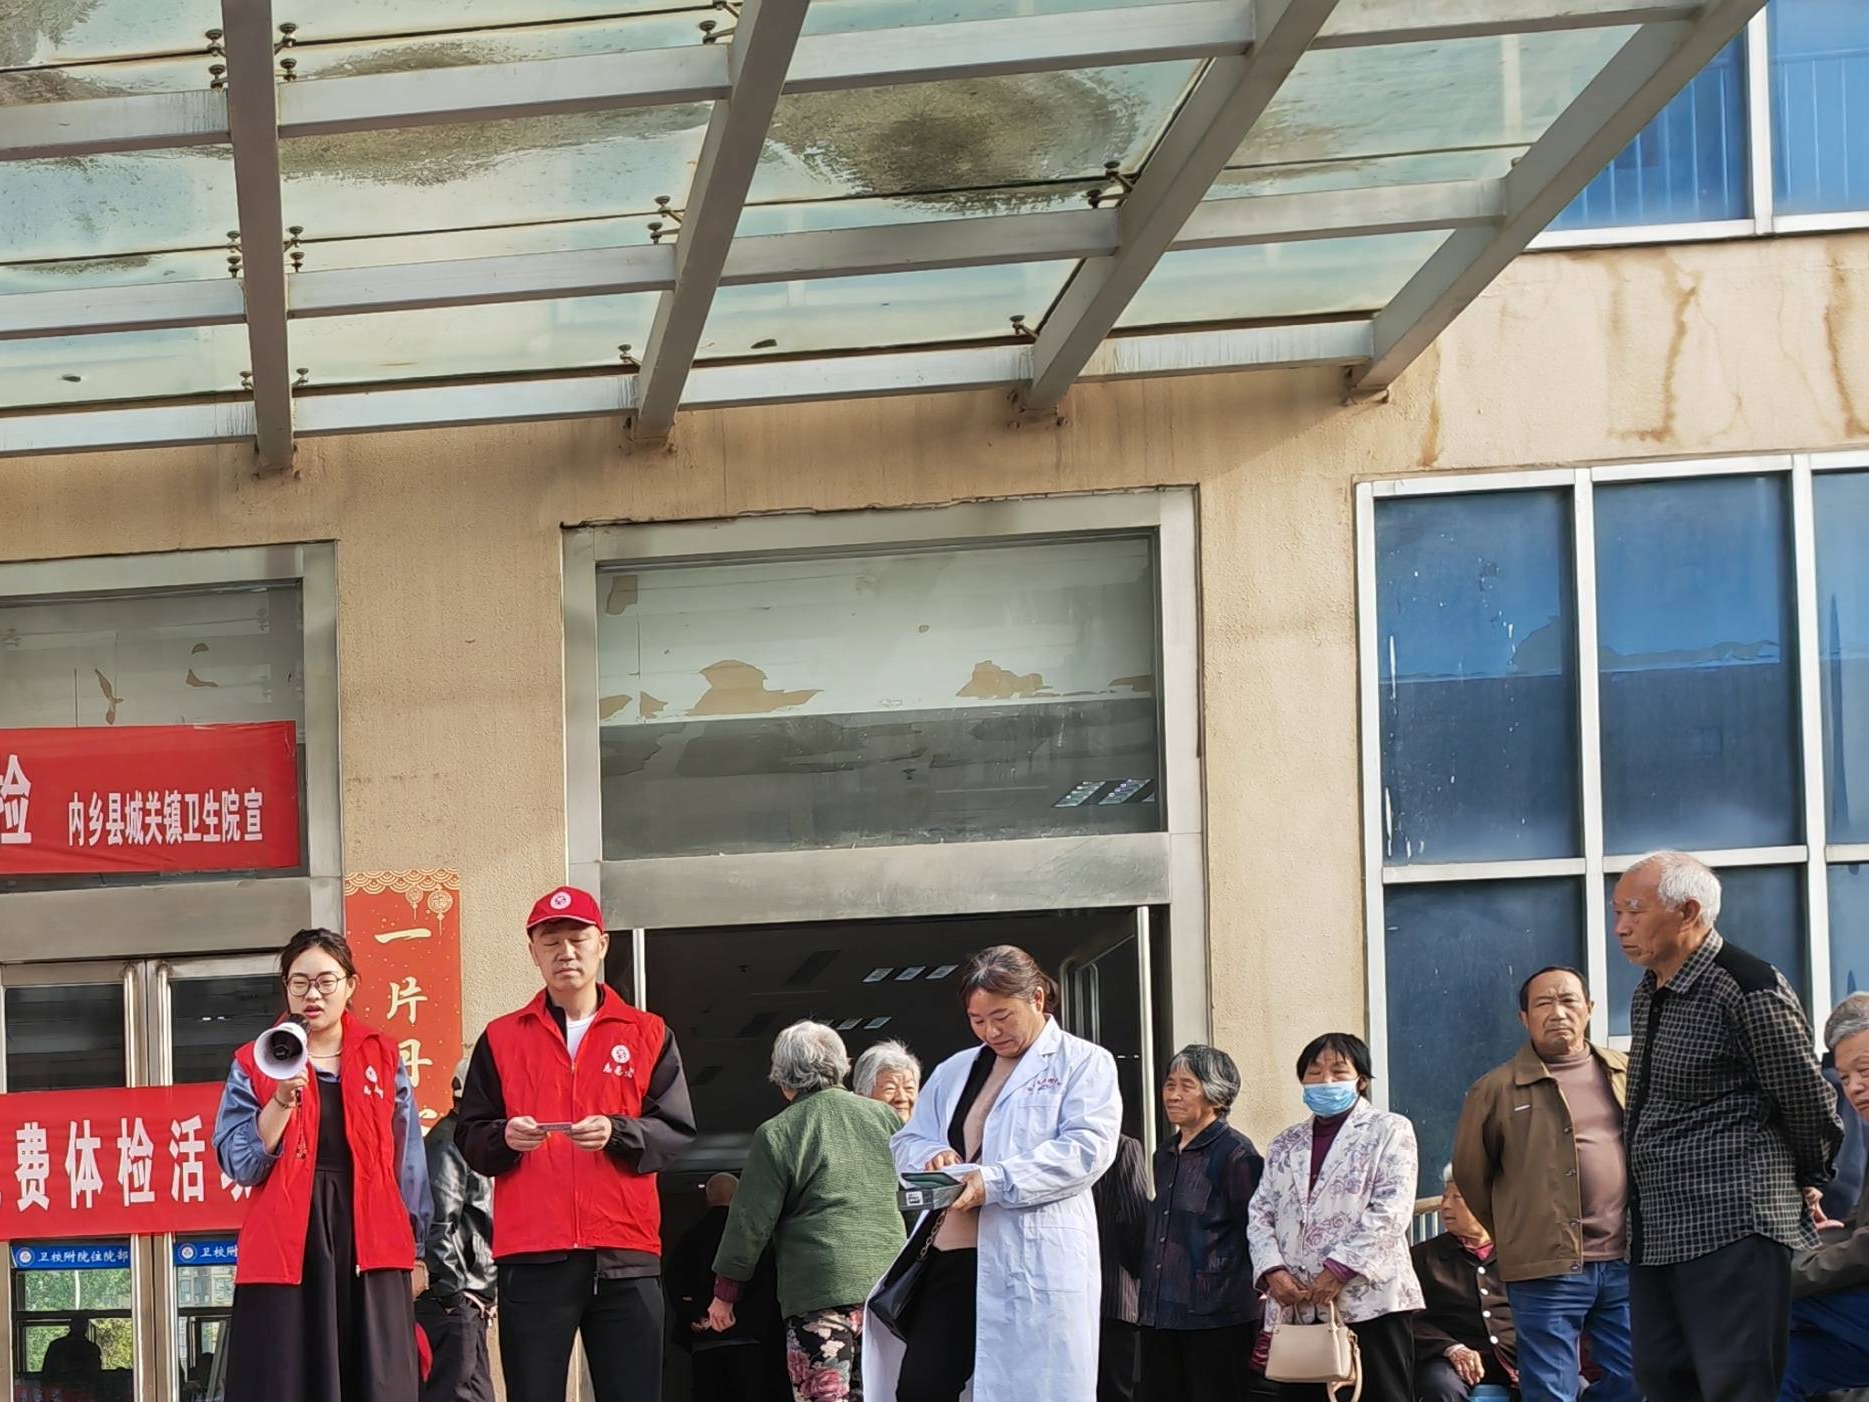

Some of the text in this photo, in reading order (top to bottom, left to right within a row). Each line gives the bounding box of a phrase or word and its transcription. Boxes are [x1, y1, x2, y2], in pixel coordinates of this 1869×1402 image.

[68, 787, 263, 846] 内乡县城关镇卫生院宣
